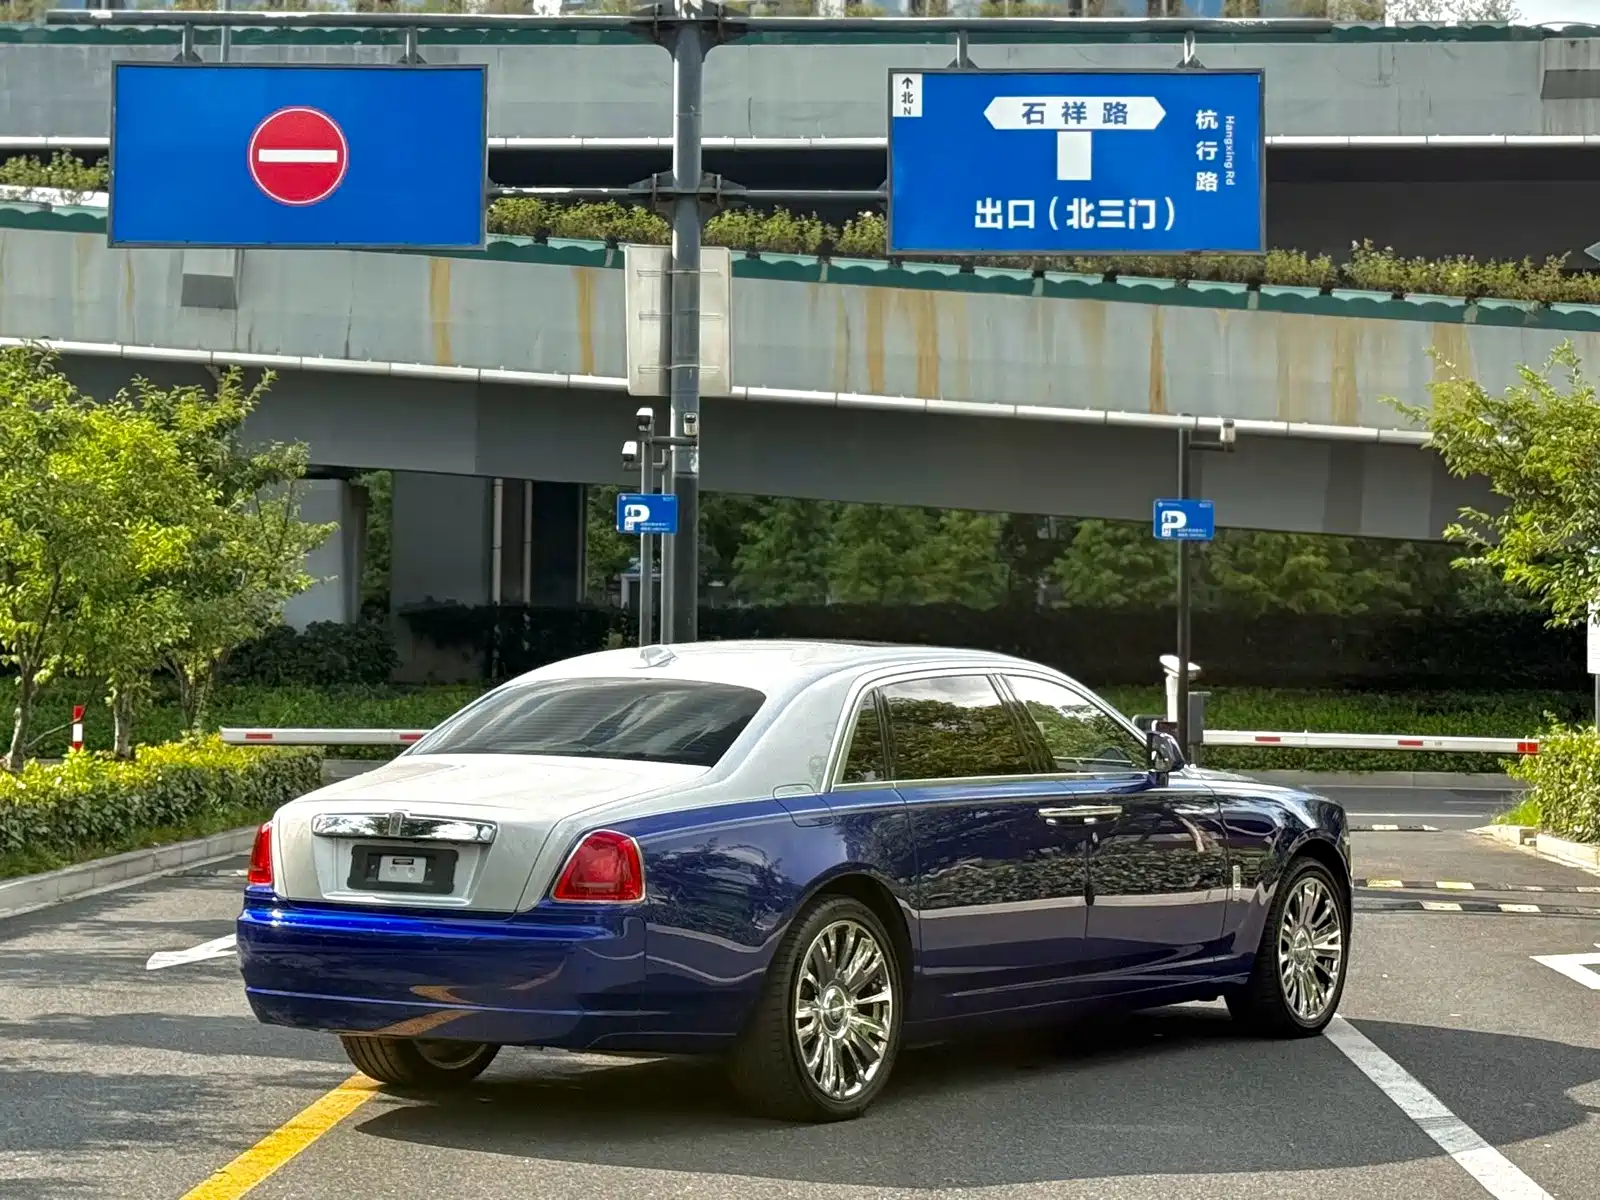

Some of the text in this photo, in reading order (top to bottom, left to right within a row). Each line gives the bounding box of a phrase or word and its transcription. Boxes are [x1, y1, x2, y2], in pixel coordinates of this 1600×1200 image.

[901, 91, 914, 104] 北
[903, 106, 911, 115] N
[1021, 101, 1128, 125] 石祥路
[1195, 109, 1218, 192] 杭行路
[1223, 115, 1236, 186] Hangxing Rd
